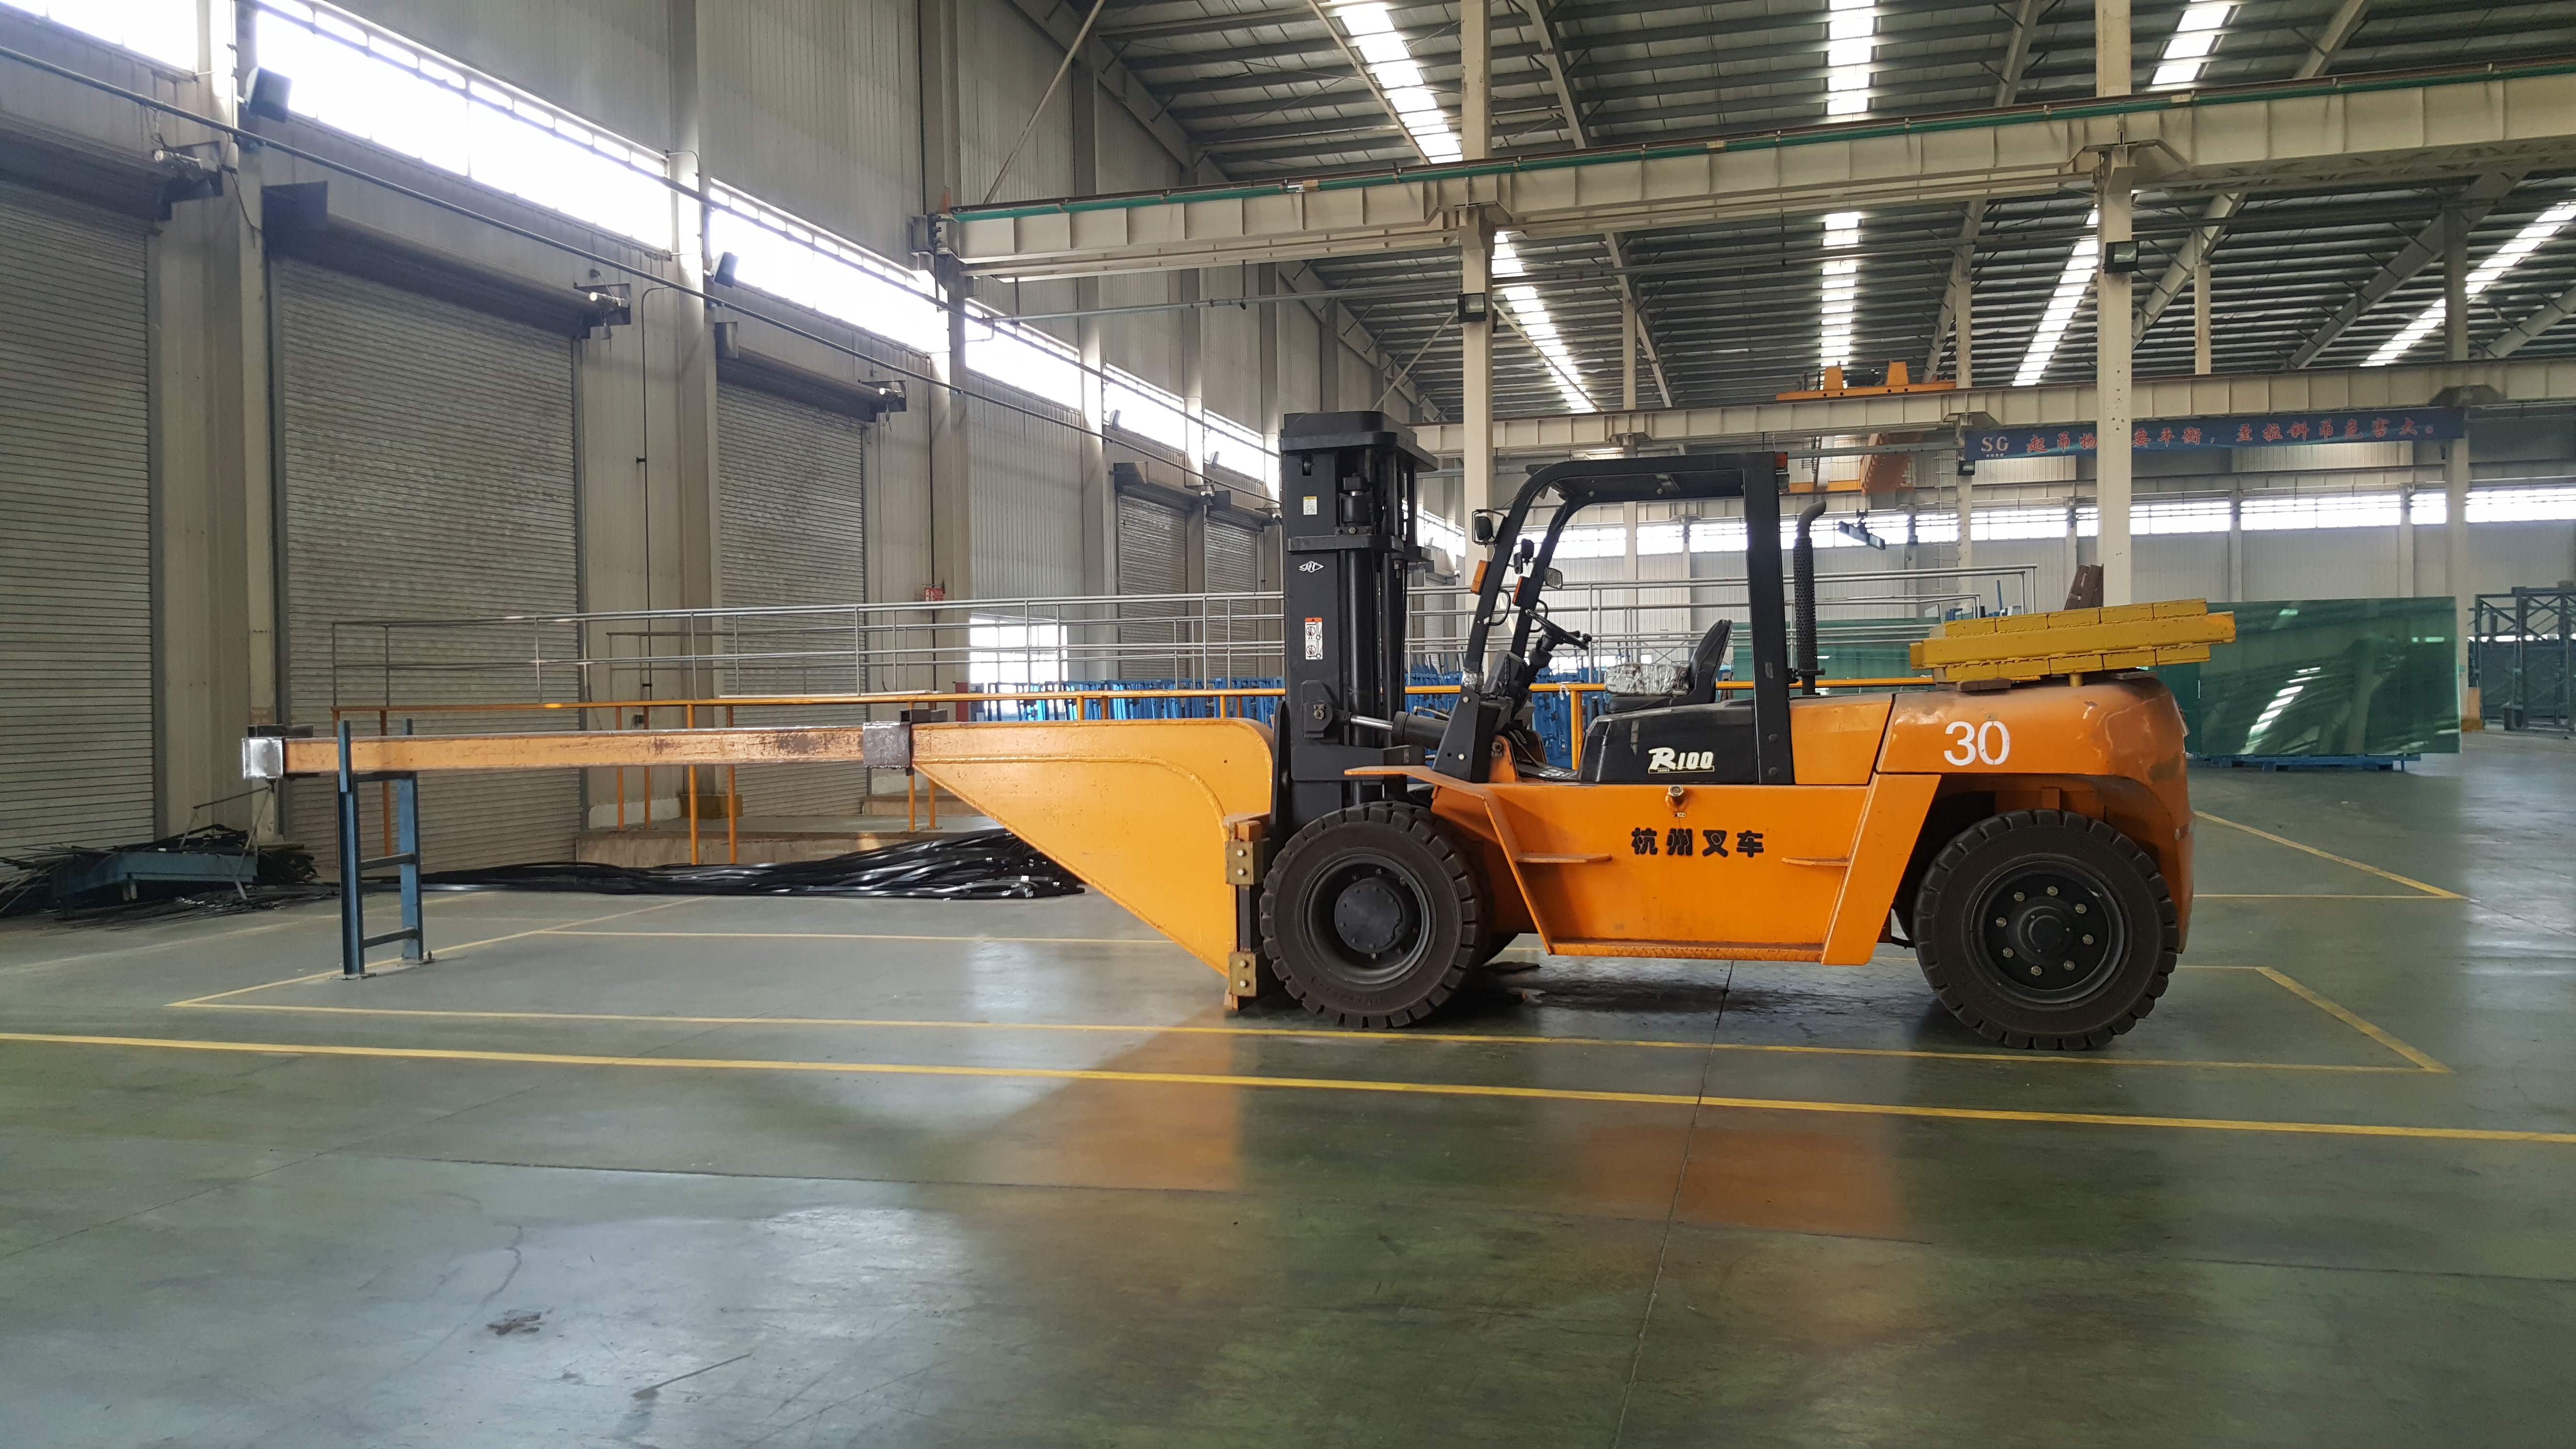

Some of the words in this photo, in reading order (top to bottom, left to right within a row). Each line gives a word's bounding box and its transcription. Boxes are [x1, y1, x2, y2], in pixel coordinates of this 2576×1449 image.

[1981, 436, 2010, 451] SG
[1944, 721, 2010, 766] 30
[1648, 747, 1714, 770] R100
[1631, 827, 1764, 857] 杭州叉车
